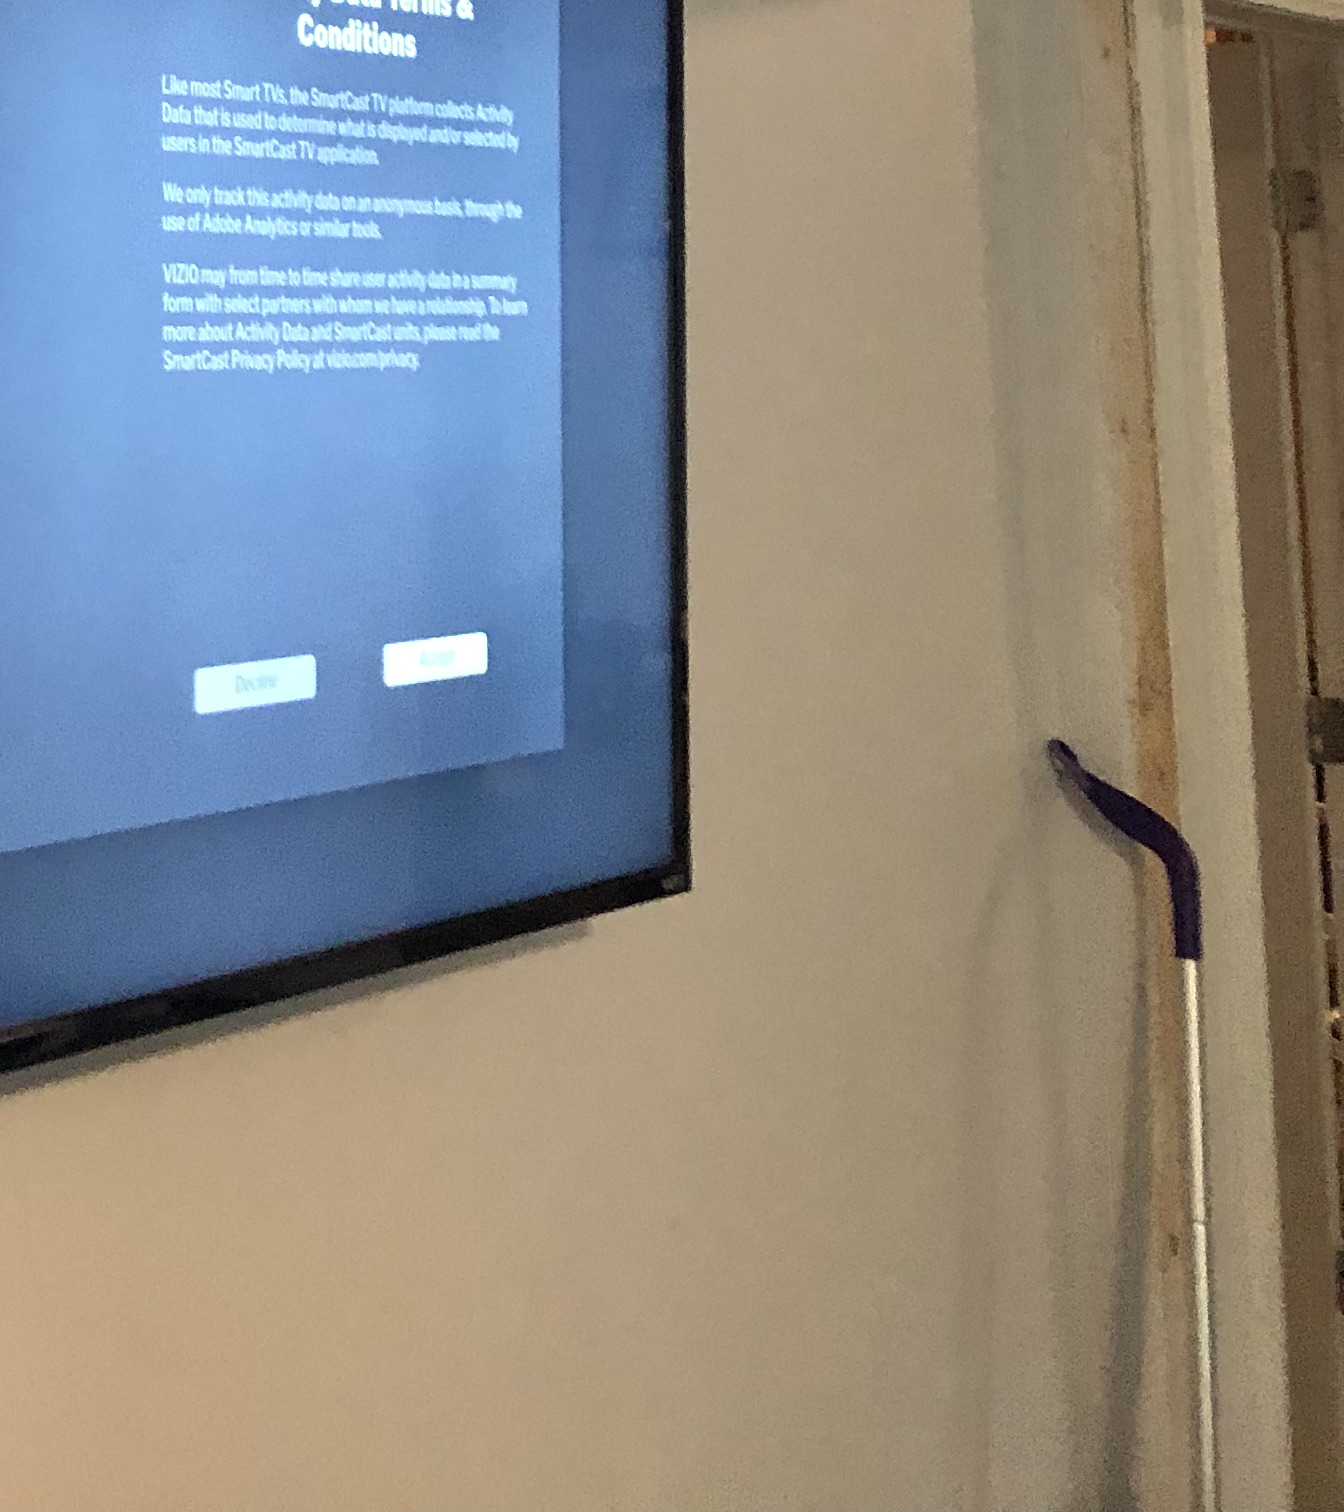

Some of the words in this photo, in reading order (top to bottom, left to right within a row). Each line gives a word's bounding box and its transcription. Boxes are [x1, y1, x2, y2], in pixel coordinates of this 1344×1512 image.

[297, 13, 417, 59] Conditions
[161, 73, 188, 96] Like
[190, 80, 222, 99] most
[224, 79, 260, 102] Smart
[289, 85, 309, 106] the
[311, 87, 370, 112] SmartCast
[371, 92, 388, 112] TV
[162, 102, 192, 125] Data
[193, 105, 219, 127] that
[221, 106, 231, 128] is
[232, 110, 262, 130] used
[263, 112, 278, 130] to
[162, 134, 197, 153] users
[198, 132, 210, 154] in
[212, 135, 232, 156] the
[234, 136, 297, 160] SmartCast
[298, 139, 316, 160] TV
[162, 181, 184, 204] We
[186, 185, 210, 208] only
[214, 186, 246, 206] track
[246, 186, 270, 207] this
[271, 188, 312, 213] activity
[162, 215, 185, 232] use
[187, 211, 201, 232] of
[203, 212, 243, 234] Adobe
[244, 214, 298, 240] Analytics
[299, 220, 311, 237] or
[162, 263, 199, 284] VIZIO
[200, 269, 226, 290] may
[229, 264, 258, 285] from
[288, 268, 301, 286] to
[162, 292, 194, 313] form
[195, 292, 222, 313] with
[224, 293, 260, 314] select
[162, 325, 196, 342] more
[198, 321, 234, 342] about
[235, 321, 279, 345] Activity
[281, 321, 310, 342] Data
[311, 322, 332, 342] and
[162, 349, 230, 371] SmartCast
[231, 348, 275, 374] Privacy
[276, 348, 311, 374] Policy
[312, 349, 325, 370] at
